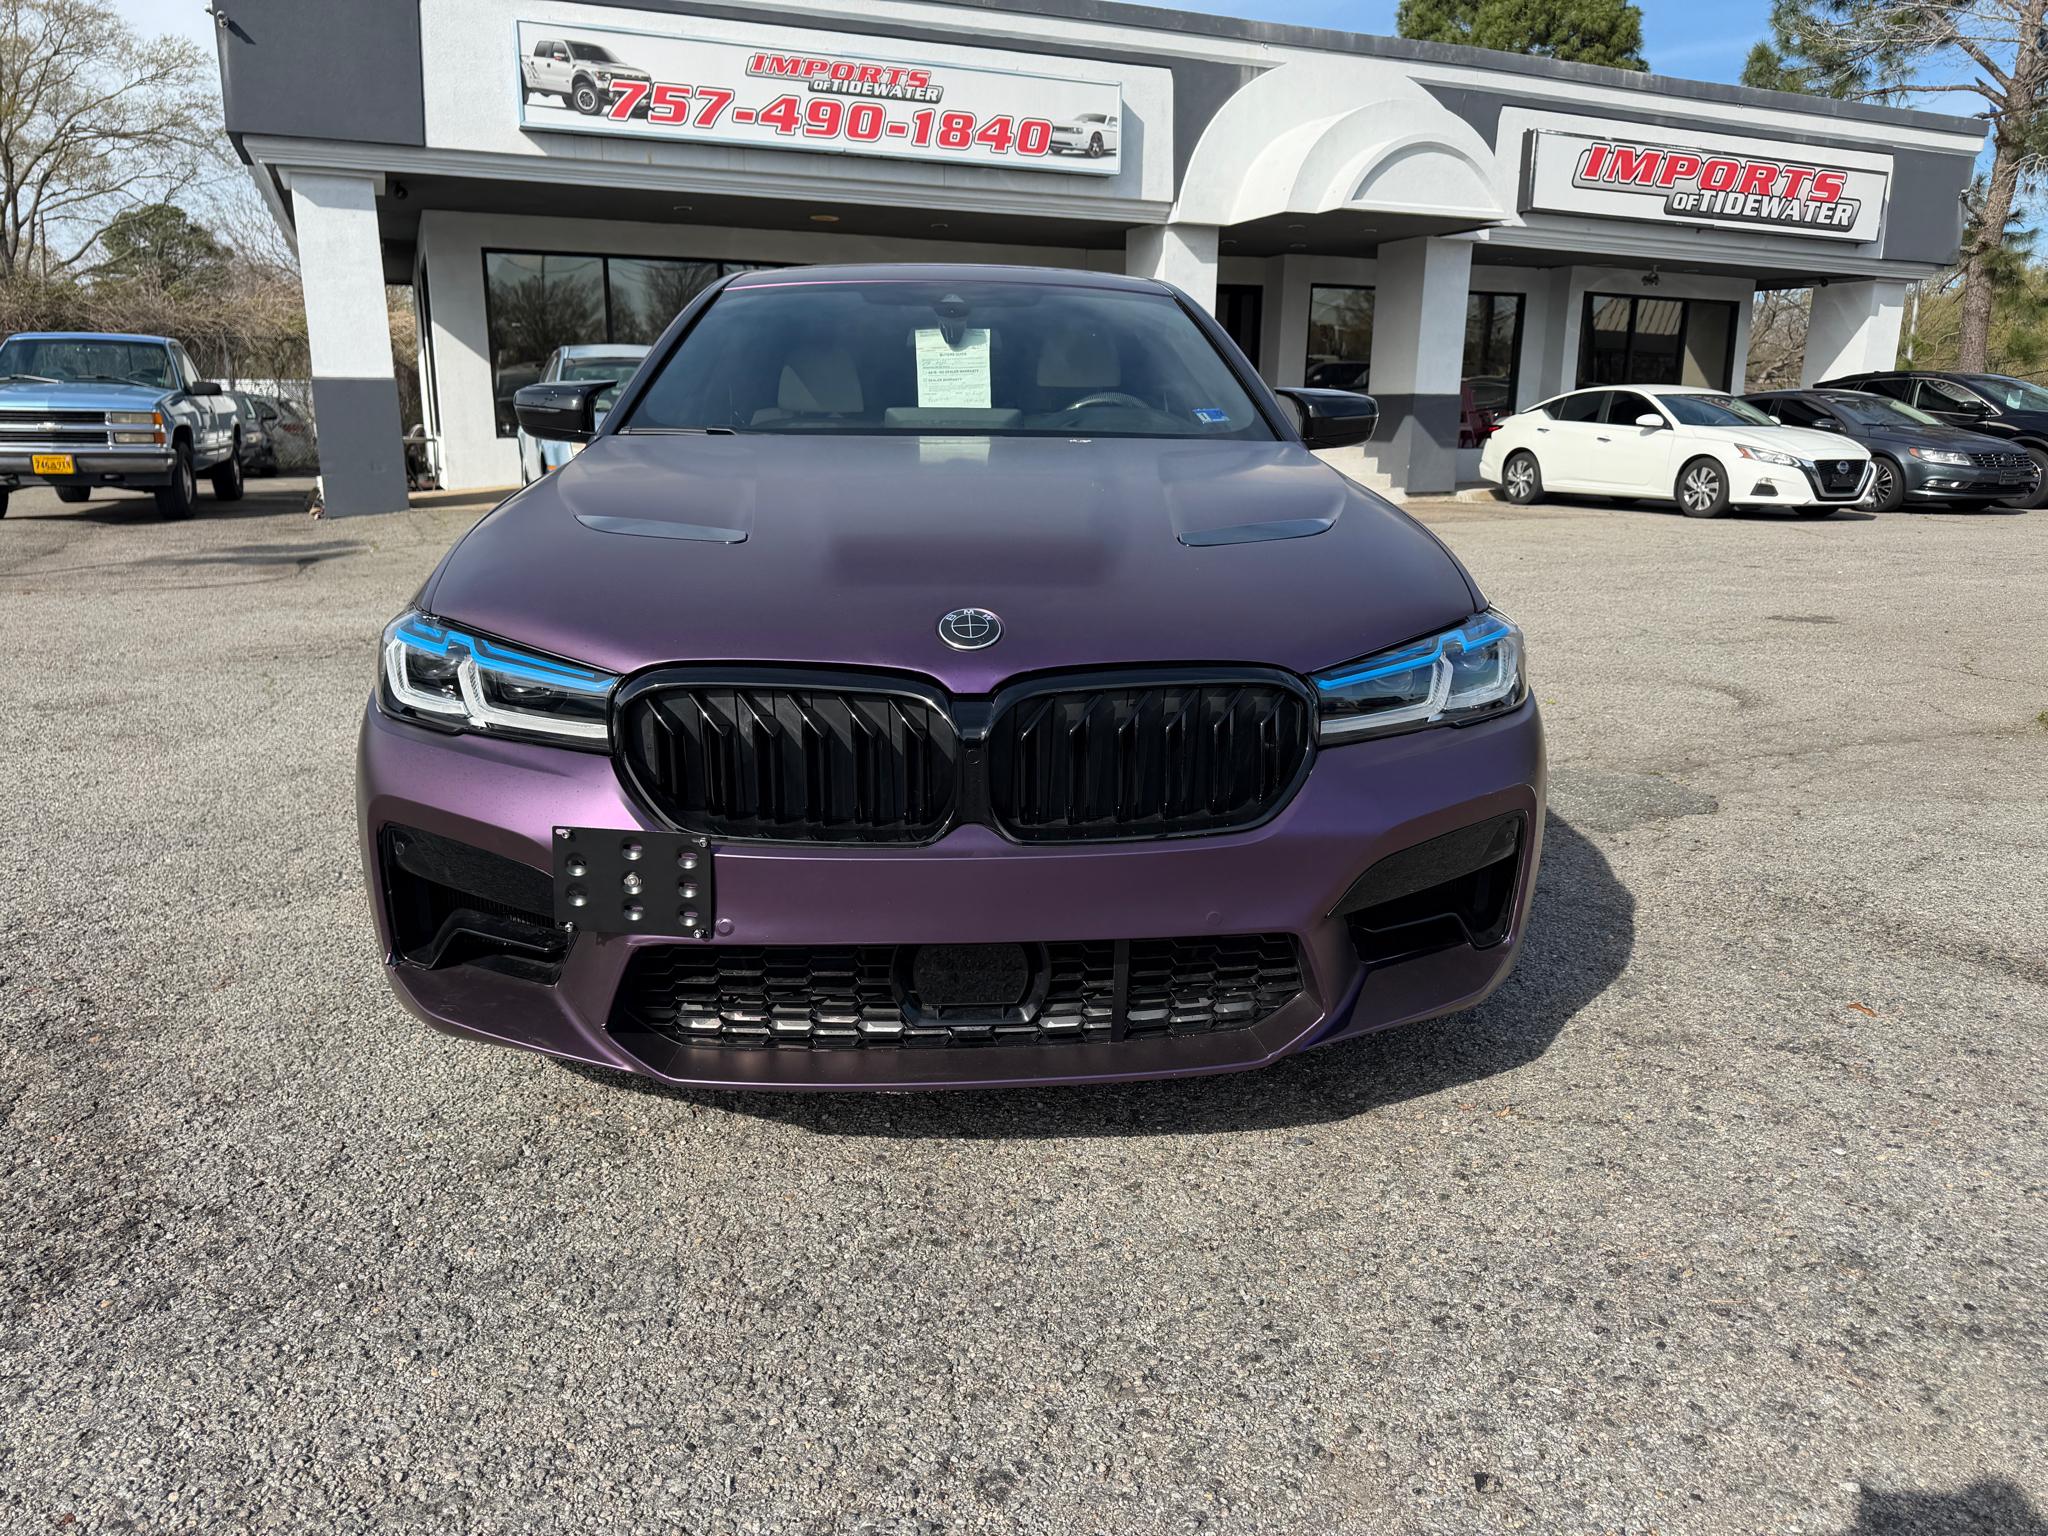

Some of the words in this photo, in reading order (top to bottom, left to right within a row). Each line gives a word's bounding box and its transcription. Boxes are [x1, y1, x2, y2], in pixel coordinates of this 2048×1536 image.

[751, 53, 931, 88] IMPORTS
[609, 80, 1054, 155] 757-490-1840
[1580, 144, 1847, 203] IMPORTS
